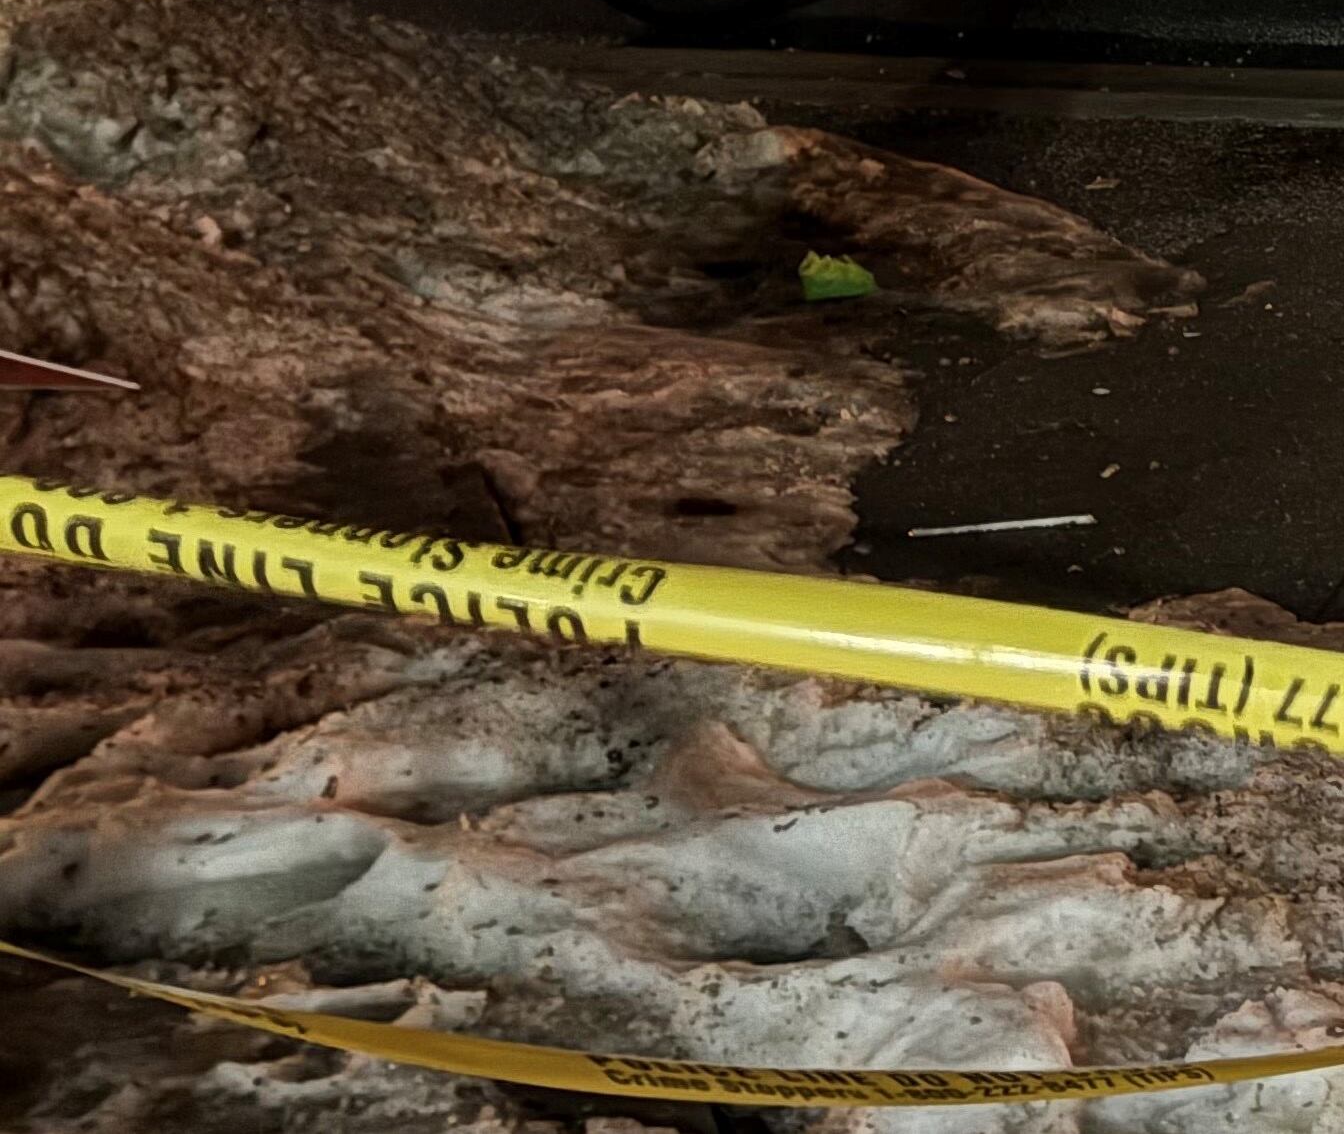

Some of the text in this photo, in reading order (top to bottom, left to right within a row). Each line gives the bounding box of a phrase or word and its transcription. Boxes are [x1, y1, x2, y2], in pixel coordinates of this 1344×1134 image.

[11, 502, 105, 561] DO
[147, 528, 319, 598] LINE
[491, 544, 667, 605] Crime
[1079, 631, 1257, 713] (TIPS)
[603, 1068, 712, 1092] Crime
[714, 1077, 870, 1102] Stoppers
[873, 1074, 1117, 1101] 1-800-222-8477
[1123, 1066, 1216, 1089] (TIPS)
[888, 1070, 951, 1087] DO
